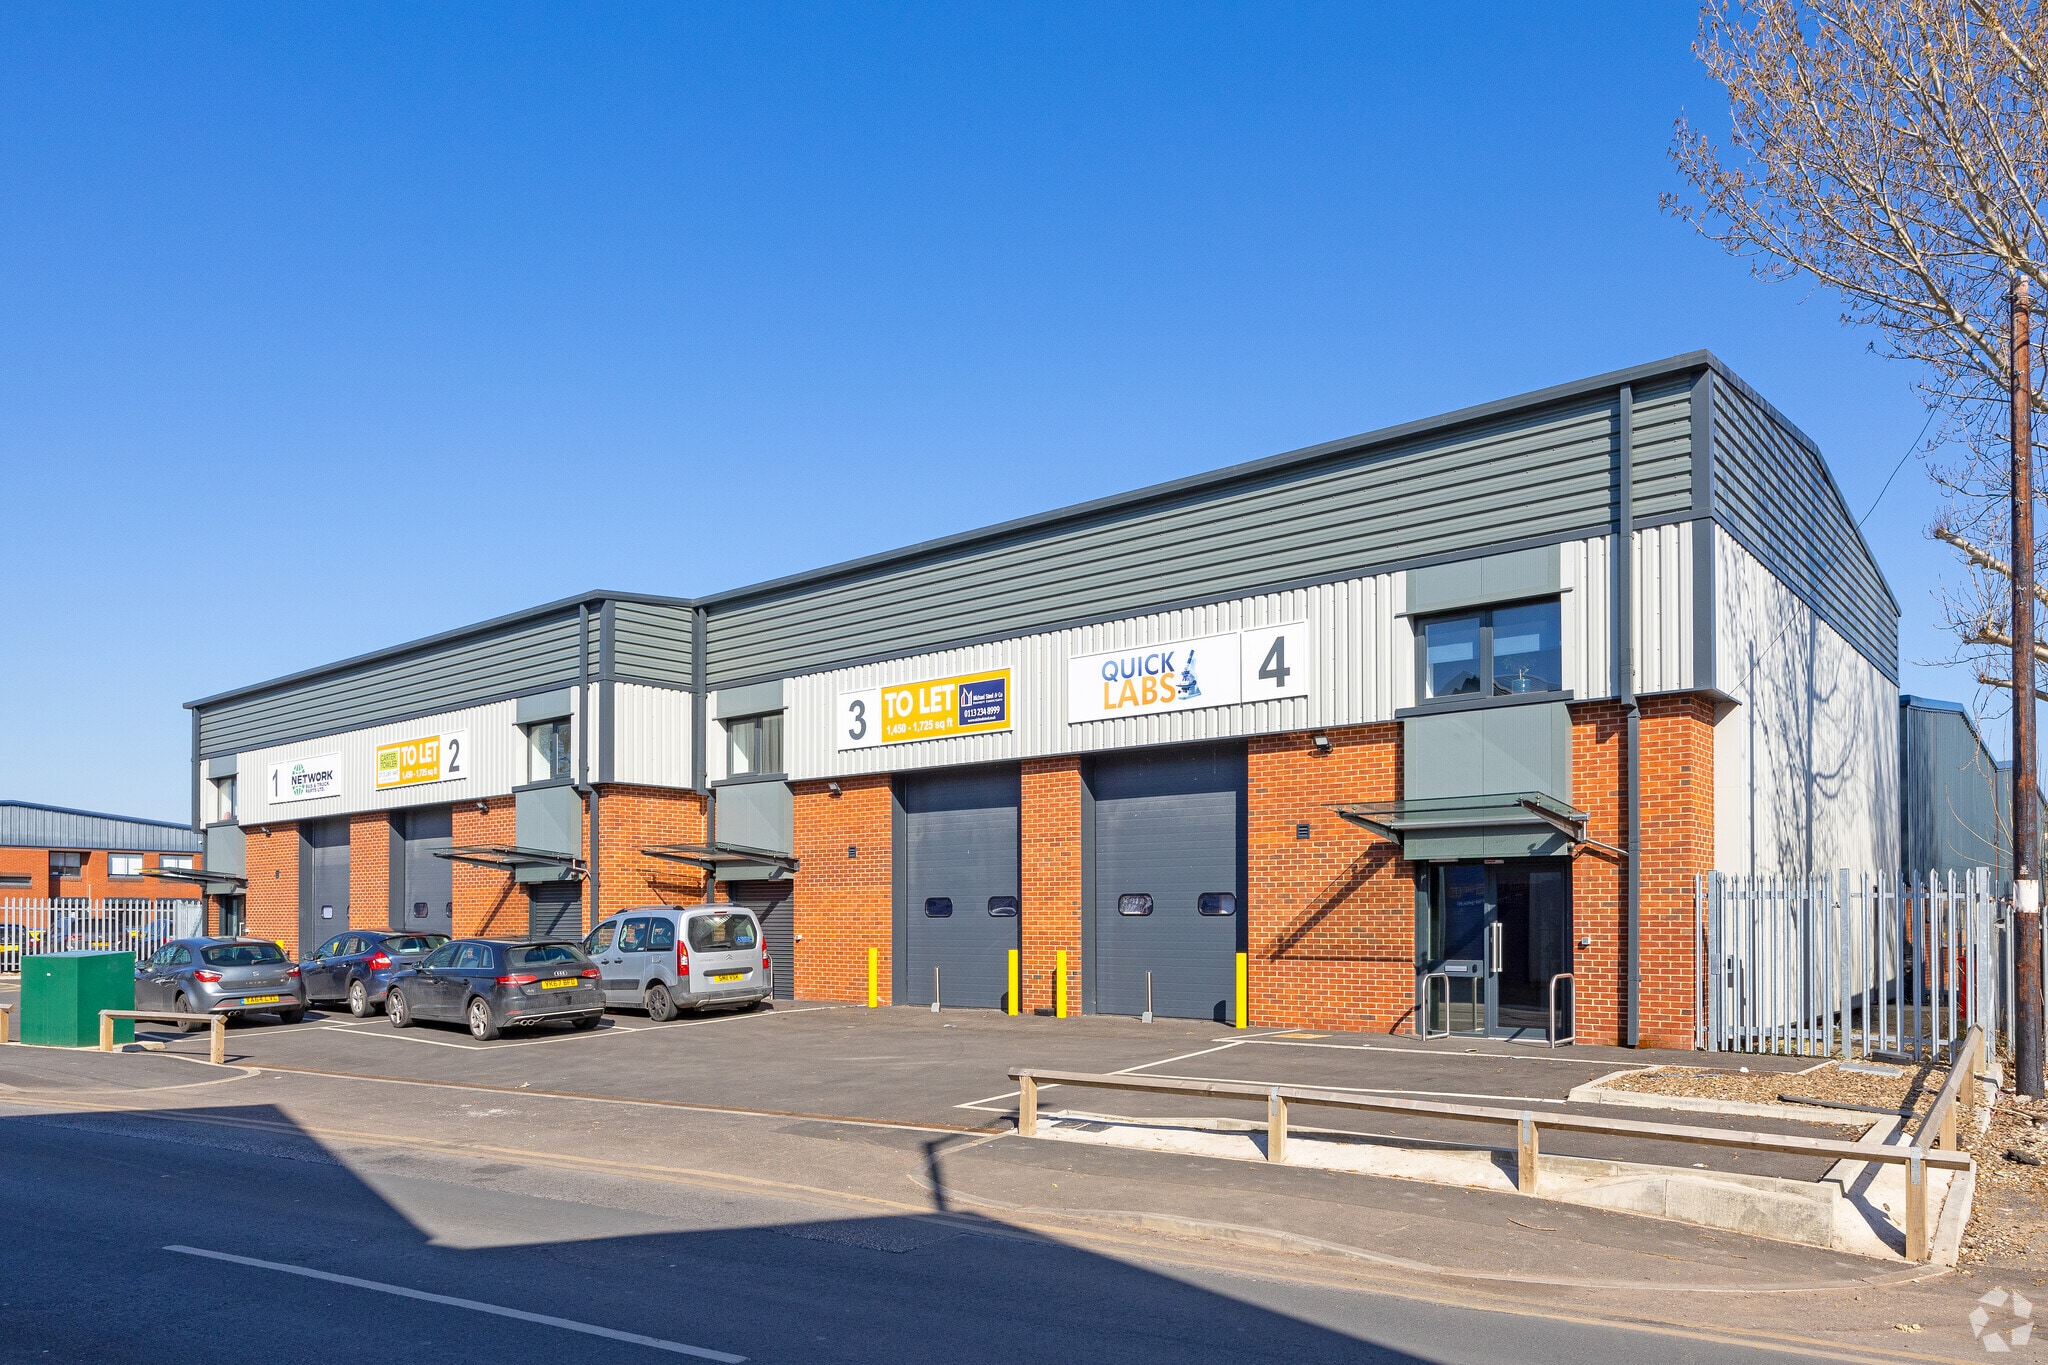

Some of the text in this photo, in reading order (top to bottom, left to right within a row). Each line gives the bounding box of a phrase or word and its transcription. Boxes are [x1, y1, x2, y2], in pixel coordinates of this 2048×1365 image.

[1101, 650, 1175, 682] QUICK
[1258, 635, 1291, 688] 4
[884, 683, 956, 719] TO LET
[1104, 672, 1176, 710] LABS
[848, 699, 867, 741] 3
[886, 723, 907, 736] 1,450
[913, 719, 934, 733] 1,725
[935, 720, 945, 731] sq
[946, 717, 953, 728] ft
[964, 709, 976, 718] 0113
[401, 740, 439, 767] TO LET
[448, 738, 460, 773] 2
[272, 769, 278, 797] 1
[291, 769, 333, 786] NETWORK
